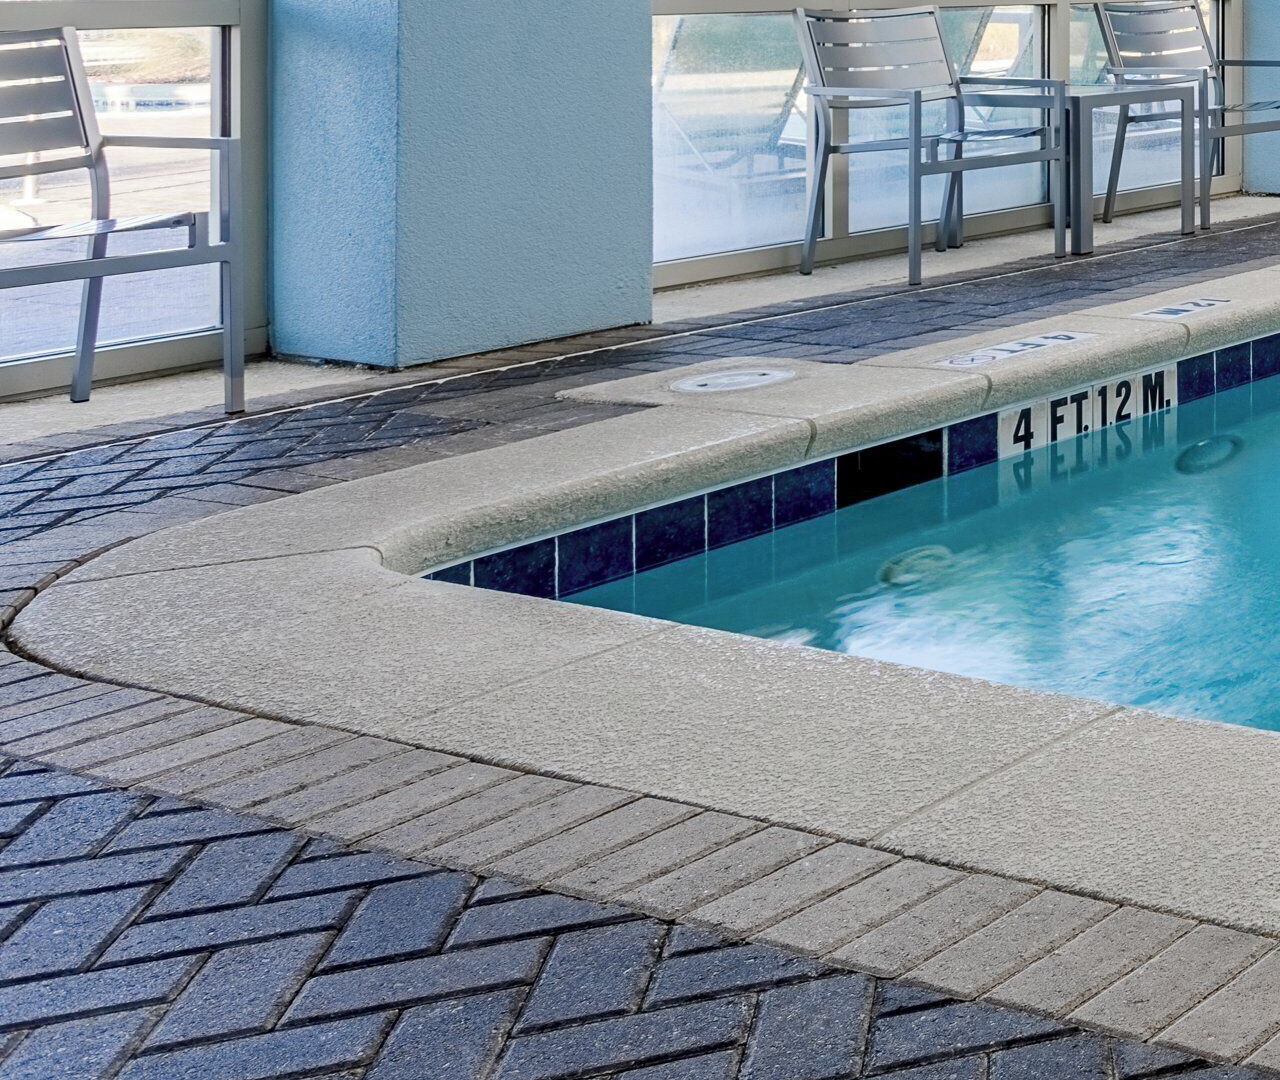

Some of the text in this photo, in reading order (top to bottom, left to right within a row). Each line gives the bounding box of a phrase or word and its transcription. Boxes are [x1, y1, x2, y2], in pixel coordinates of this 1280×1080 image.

[1013, 407, 1034, 450] 4
[1050, 390, 1090, 442] FT.
[1142, 370, 1171, 415] M.
